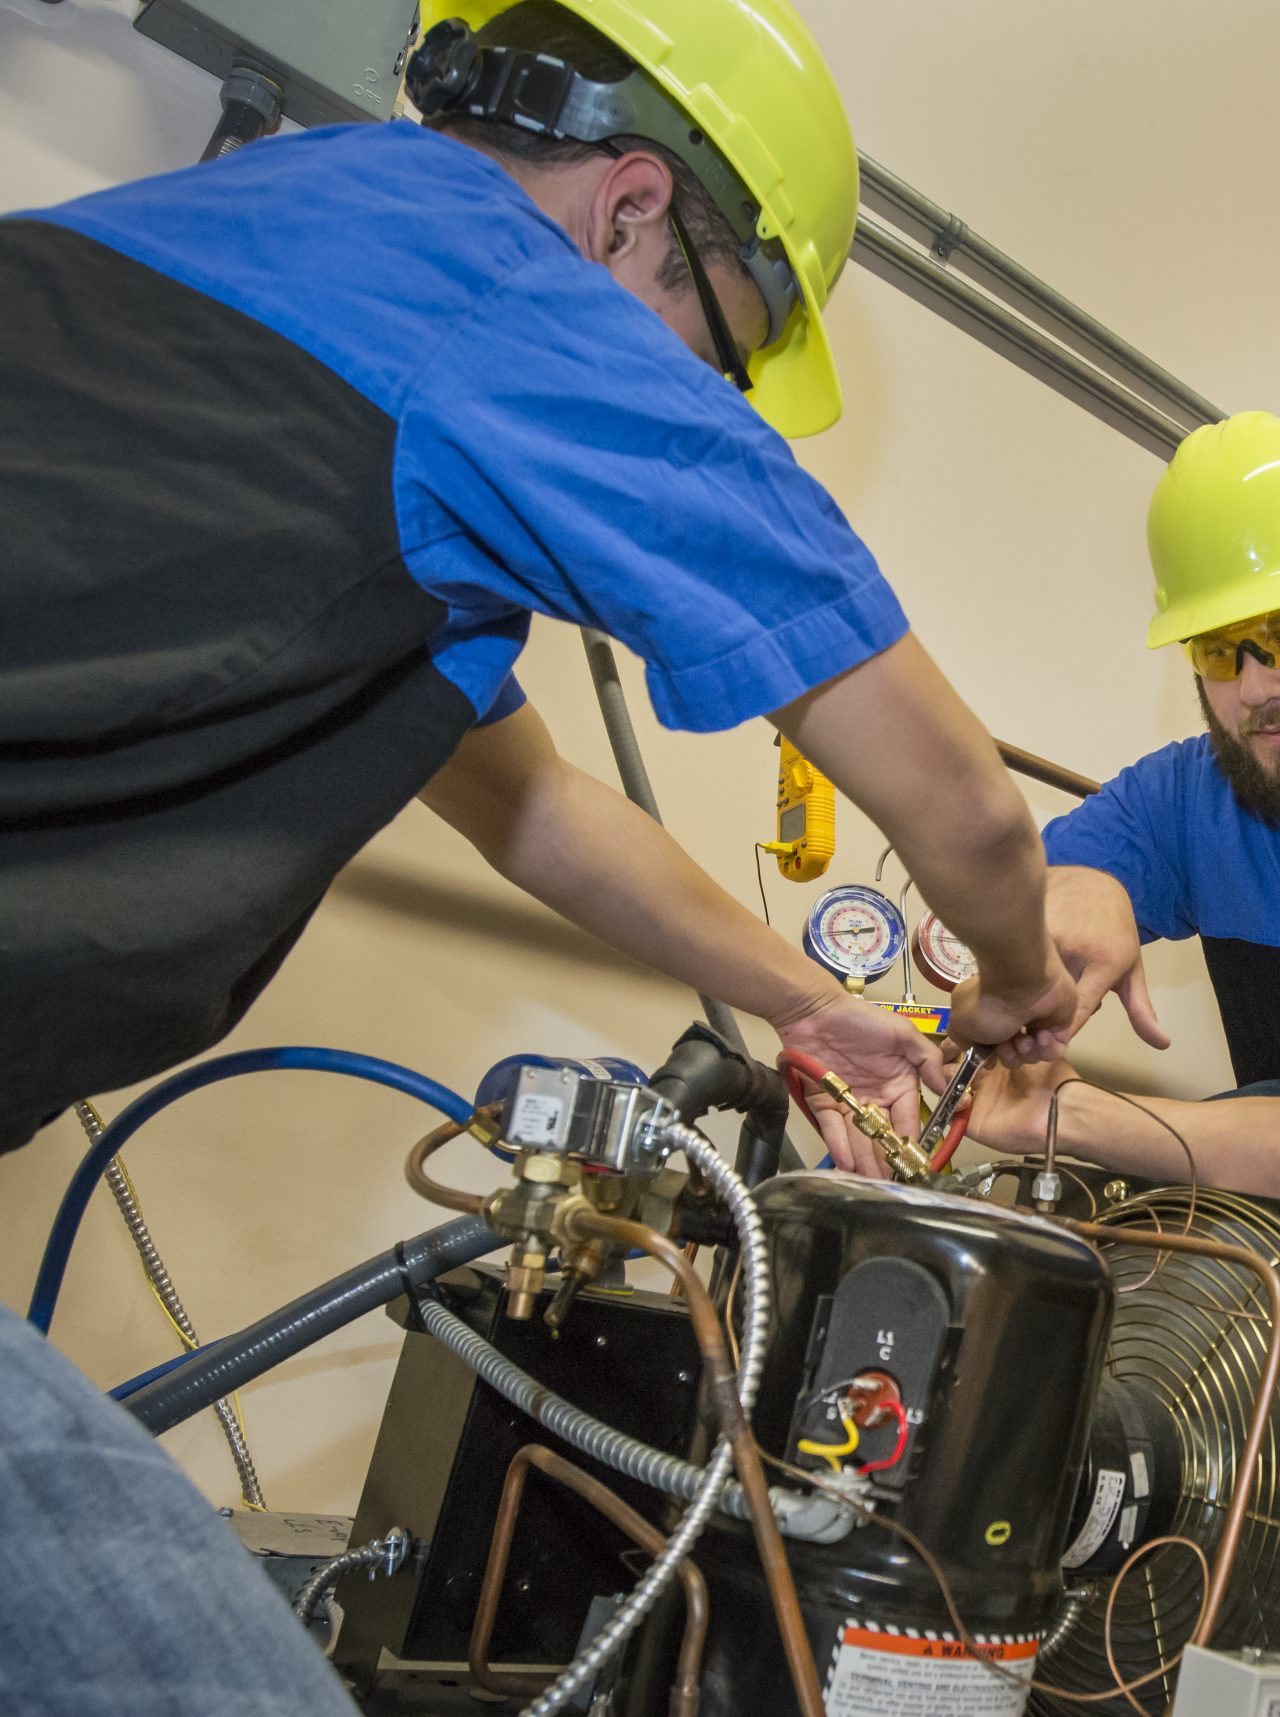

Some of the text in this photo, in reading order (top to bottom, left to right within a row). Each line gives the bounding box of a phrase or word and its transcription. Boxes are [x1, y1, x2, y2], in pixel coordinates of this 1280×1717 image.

[897, 1005, 932, 1014] JACKET
[876, 1329, 894, 1346] L1
[879, 1345, 892, 1361] C
